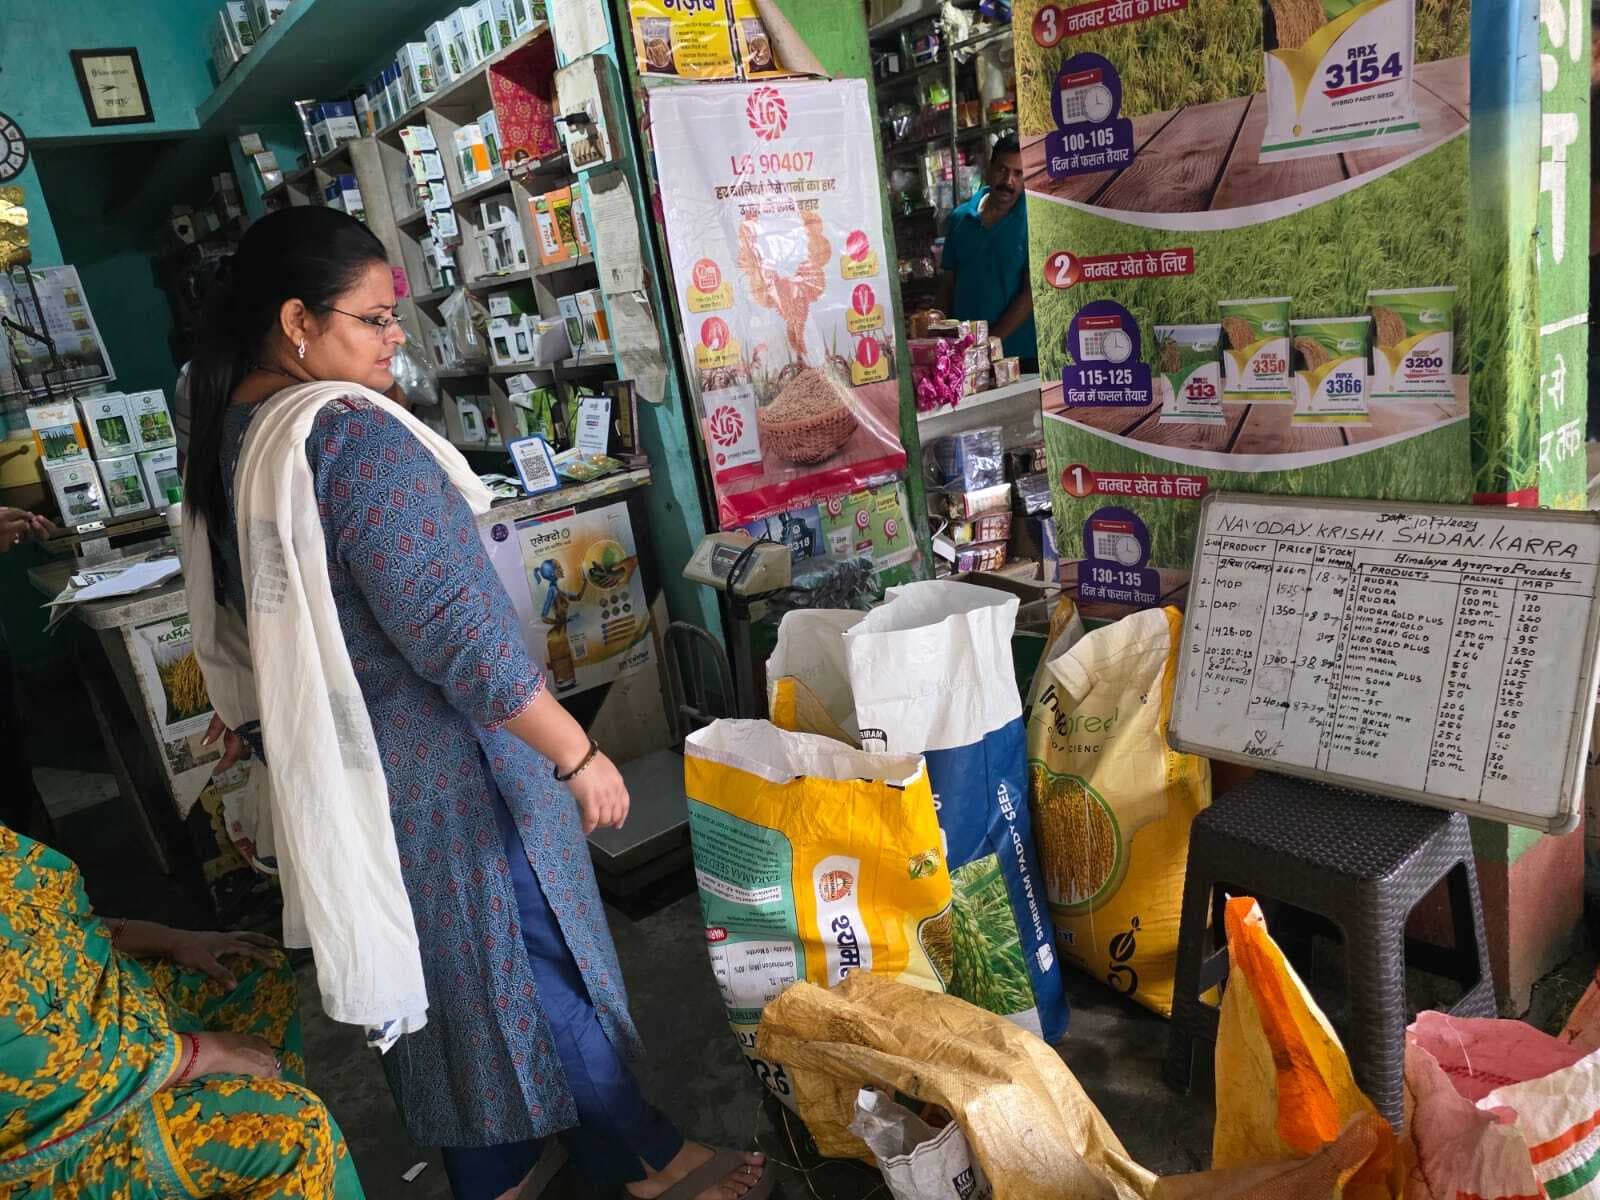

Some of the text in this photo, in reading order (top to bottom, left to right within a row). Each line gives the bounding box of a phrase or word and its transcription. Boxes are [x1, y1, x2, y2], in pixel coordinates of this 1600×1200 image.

[1042, 9, 1057, 42] 3
[1067, 8, 1106, 31] नम्बर
[1347, 43, 1378, 60] RRX
[1325, 51, 1403, 89] 3154
[1331, 99, 1354, 107] HYBRID
[1377, 91, 1394, 99] SEED
[759, 101, 776, 125] LG
[1061, 128, 1114, 153] 100-105
[730, 151, 814, 176] LG 90407
[1052, 147, 1129, 172] दिन में फसल तैयार
[1055, 252, 1188, 285] 2 नम्बर खेत के लिए
[1252, 359, 1286, 374] 3350
[1405, 357, 1444, 369] 3200
[1078, 369, 1133, 386] 115-125
[1068, 387, 1149, 402] दिन में फसल तैयार
[1186, 384, 1216, 397] 113
[1326, 379, 1362, 394] 3366
[719, 416, 734, 435] LG
[1072, 467, 1202, 497] 1 नम्बर खेत के लिए
[1222, 541, 1267, 552] PRODUCT
[1279, 543, 1312, 554] PRICE
[1489, 525, 1578, 558] KARRA
[1394, 552, 1449, 569] Himalaya
[1092, 567, 1142, 587] 130-135
[1216, 579, 1243, 588] MOP
[1370, 567, 1554, 590] PRODUCTS PACKING MRP
[1081, 583, 1157, 605] दिन में फसल तैयार
[1364, 577, 1539, 602] RUDRA 50 ML 70
[1359, 595, 1396, 605] RUDRA
[1361, 585, 1397, 596] RUDRA
[1462, 596, 1480, 606] 100
[1521, 604, 1541, 613] 120
[1213, 601, 1296, 616] DAP 1350
[1357, 605, 1388, 616] RUDRA
[1391, 610, 1415, 621] GOLD
[1418, 615, 1443, 626] PLUS
[1457, 617, 1477, 626] 100
[1401, 631, 1430, 642] GOLD
[1512, 646, 1536, 657] 350
[1518, 635, 1539, 645] 95
[1375, 638, 1401, 649] GOLD
[1403, 641, 1431, 655] PLUS
[1507, 657, 1534, 668] 145
[1395, 671, 1422, 683] PLUS
[1503, 710, 1520, 719] 65
[1496, 720, 1516, 730] 300
[1354, 737, 1380, 748] SURE
[1497, 731, 1511, 740] 60
[1489, 752, 1504, 762] 30
[997, 783, 1044, 941] SHRIRAM PADDY SEED
[762, 960, 794, 971] Germination
